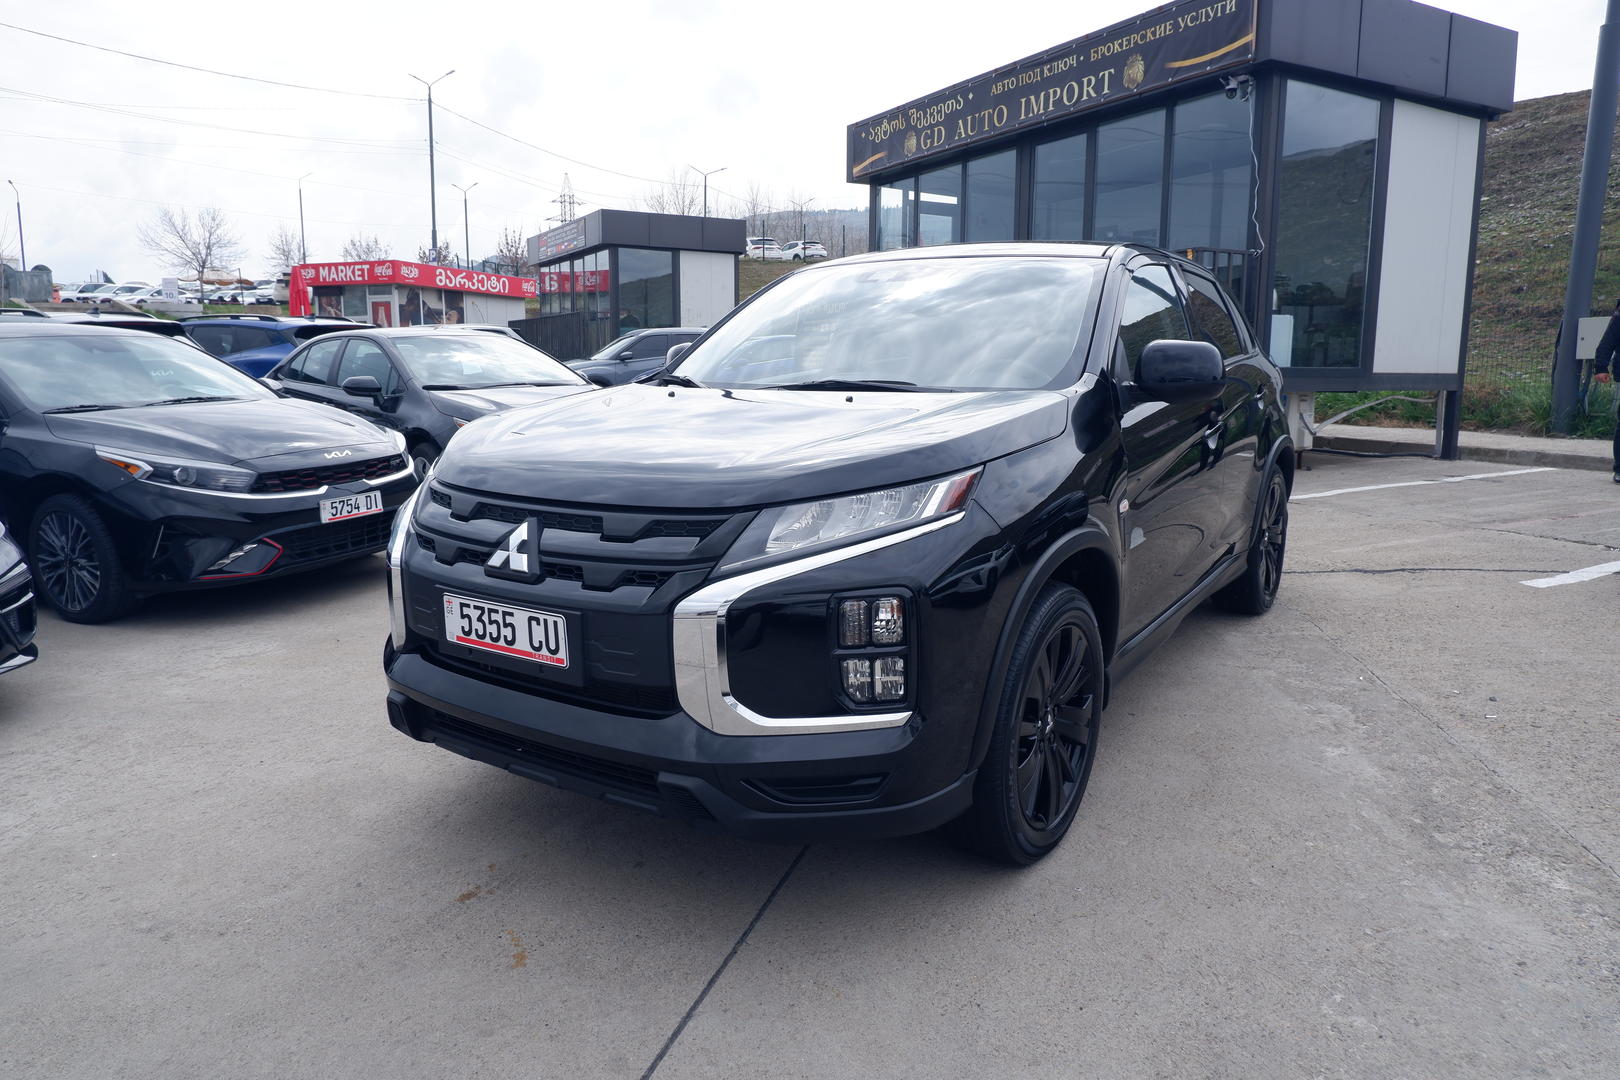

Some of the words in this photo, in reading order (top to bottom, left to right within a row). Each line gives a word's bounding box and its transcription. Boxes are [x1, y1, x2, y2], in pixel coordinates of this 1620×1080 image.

[990, 77, 1017, 96] АВТО
[1019, 70, 1041, 87] ПОД
[1043, 54, 1078, 77] КЛЮЧ
[1090, 20, 1174, 62] БРОКЕРСКИЕ
[1177, 0, 1237, 32] УСЛУГИ
[868, 113, 906, 143] ავტოს
[908, 95, 964, 128] შეკვეთა
[920, 125, 945, 150] GD
[954, 104, 1008, 140] AUTO
[1019, 68, 1114, 120] IMPORT
[320, 265, 370, 282] MARKET
[436, 268, 509, 294] მარკეტი
[330, 497, 360, 517] 5754
[365, 493, 379, 511] DI
[459, 601, 517, 647] 5355
[527, 615, 560, 656] CU
